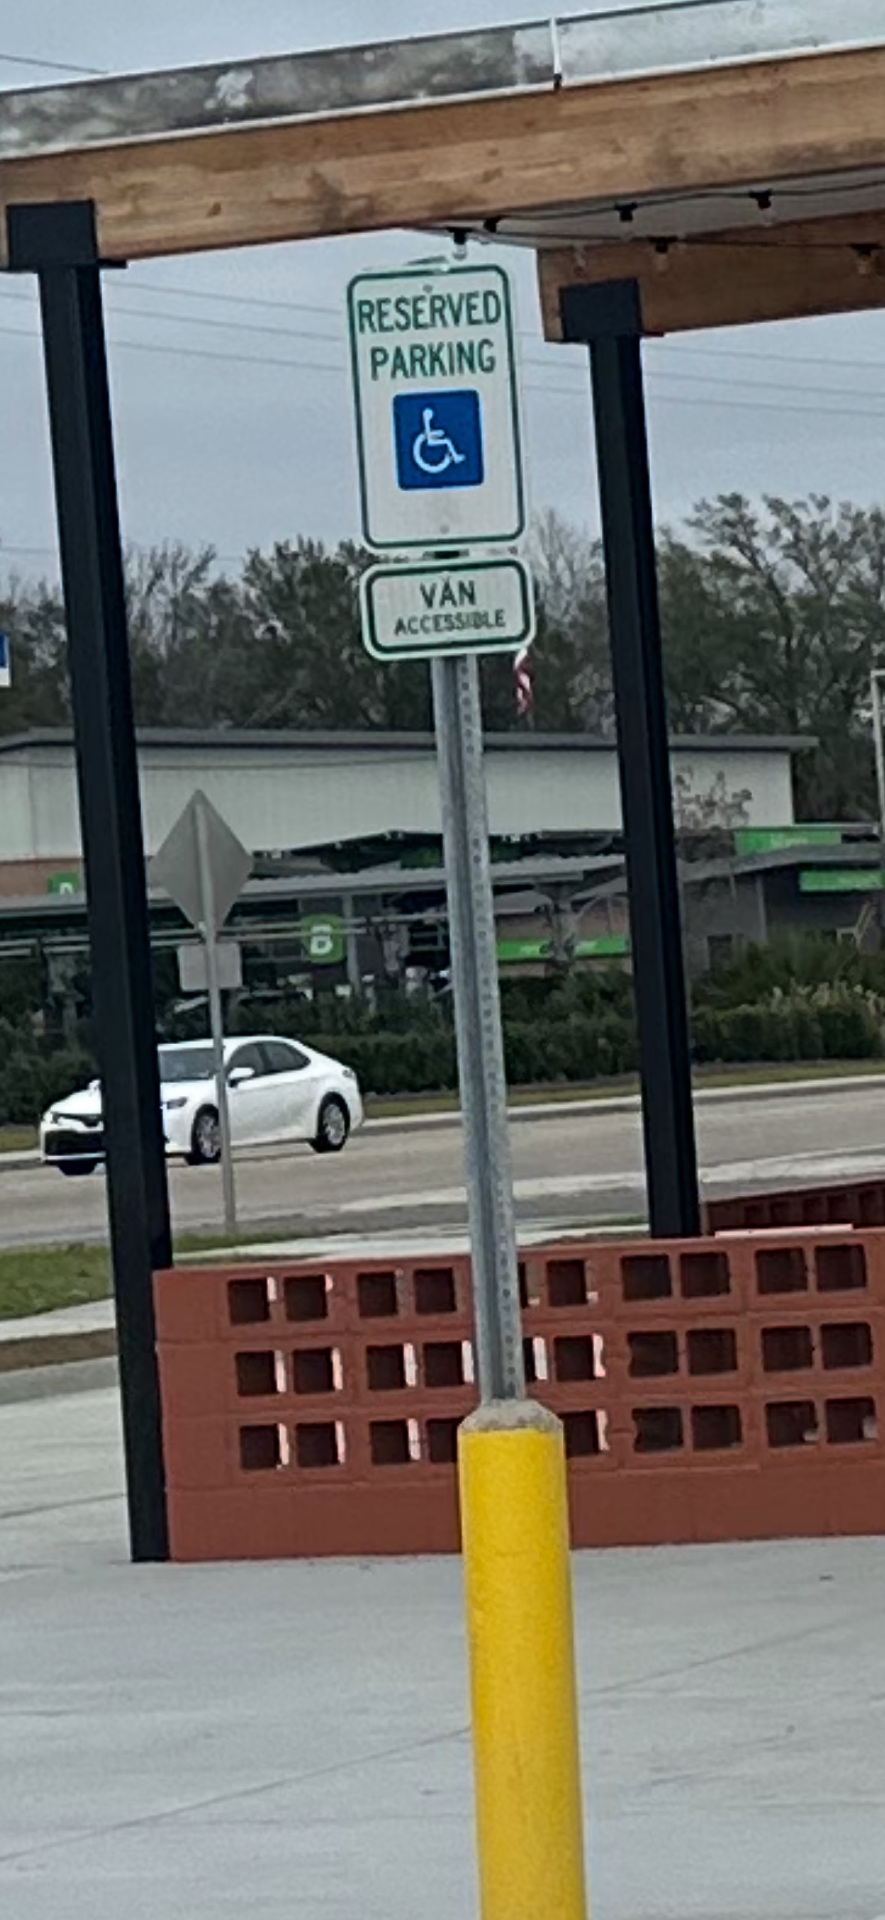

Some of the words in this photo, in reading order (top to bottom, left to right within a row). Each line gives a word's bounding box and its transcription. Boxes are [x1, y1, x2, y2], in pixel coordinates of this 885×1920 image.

[357, 290, 501, 333] RESERVED
[371, 339, 495, 381] PARKING
[420, 579, 476, 609] VAN
[394, 609, 505, 636] ACCESSIBLE
